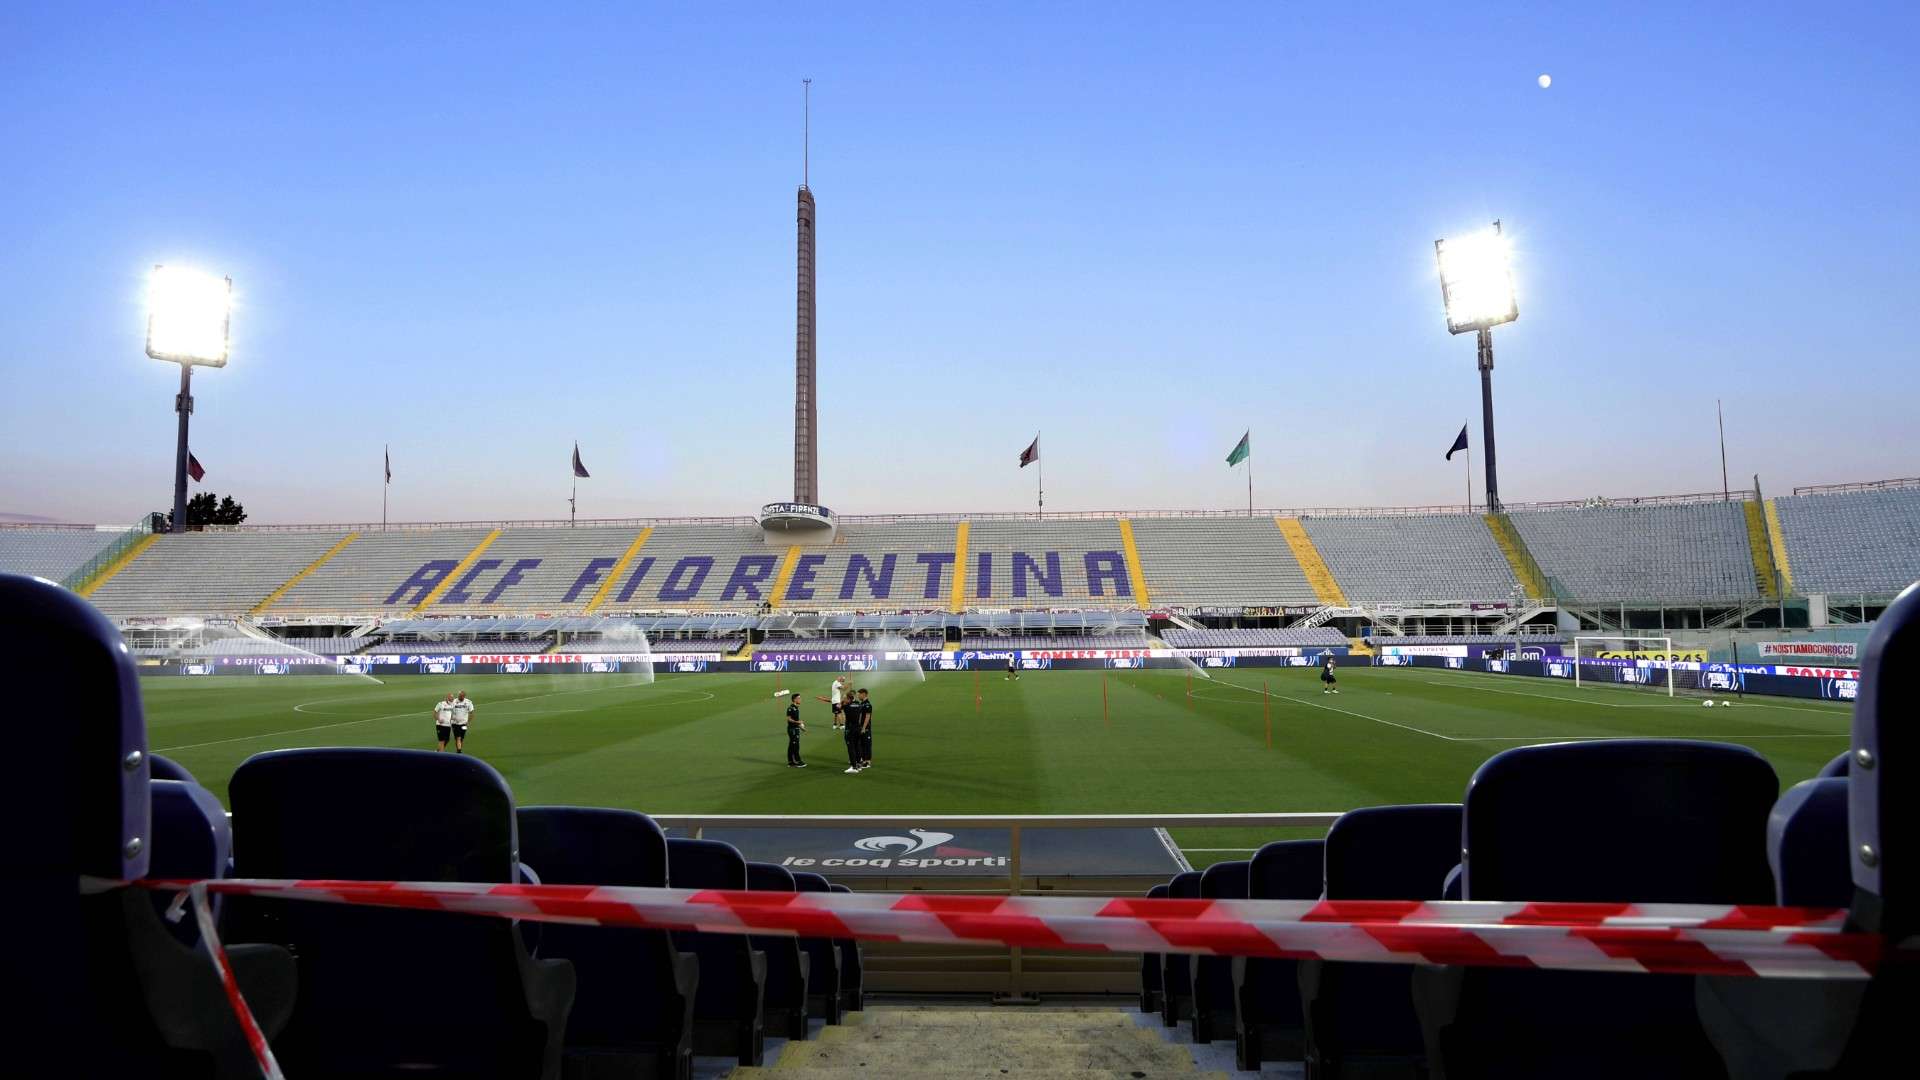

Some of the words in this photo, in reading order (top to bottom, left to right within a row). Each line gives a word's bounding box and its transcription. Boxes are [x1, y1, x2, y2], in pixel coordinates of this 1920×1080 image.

[790, 505, 820, 515] FIRENZE
[383, 559, 542, 604] ACF
[560, 550, 1131, 603] FIORENTINA
[1764, 644, 1854, 655] #NOISTIAMOCONROCCO
[469, 655, 530, 664] TOMKET
[538, 655, 582, 663] TIRES
[775, 654, 822, 662] OFFICIAL
[1030, 650, 1097, 660] TOMKET
[1104, 650, 1152, 659] TIRES
[235, 658, 280, 666] OFFICIAL
[283, 657, 327, 665] PARTNER
[782, 856, 816, 867] le
[822, 857, 892, 869] coq
[897, 856, 1011, 869] sporti
